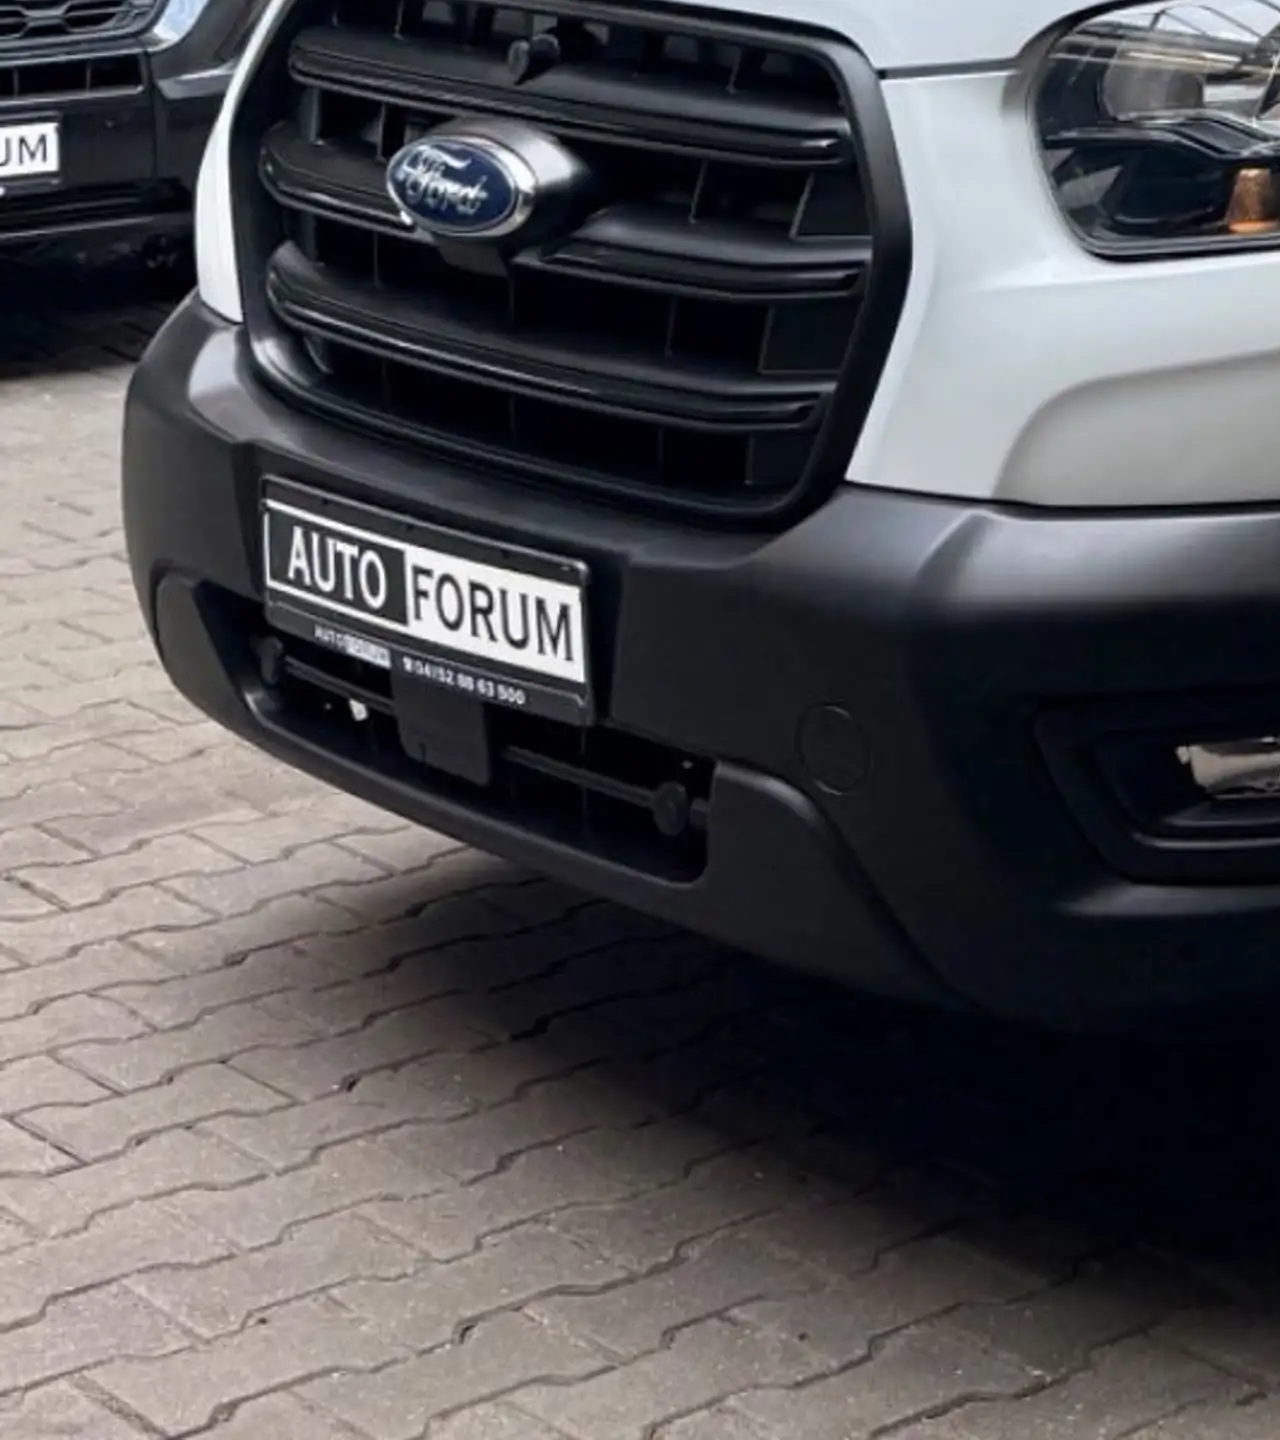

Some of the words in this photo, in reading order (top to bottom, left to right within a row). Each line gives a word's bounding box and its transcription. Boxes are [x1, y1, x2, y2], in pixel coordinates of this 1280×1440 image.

[397, 144, 488, 215] Ford
[287, 525, 388, 610] AUTO
[412, 565, 574, 662] FORUM
